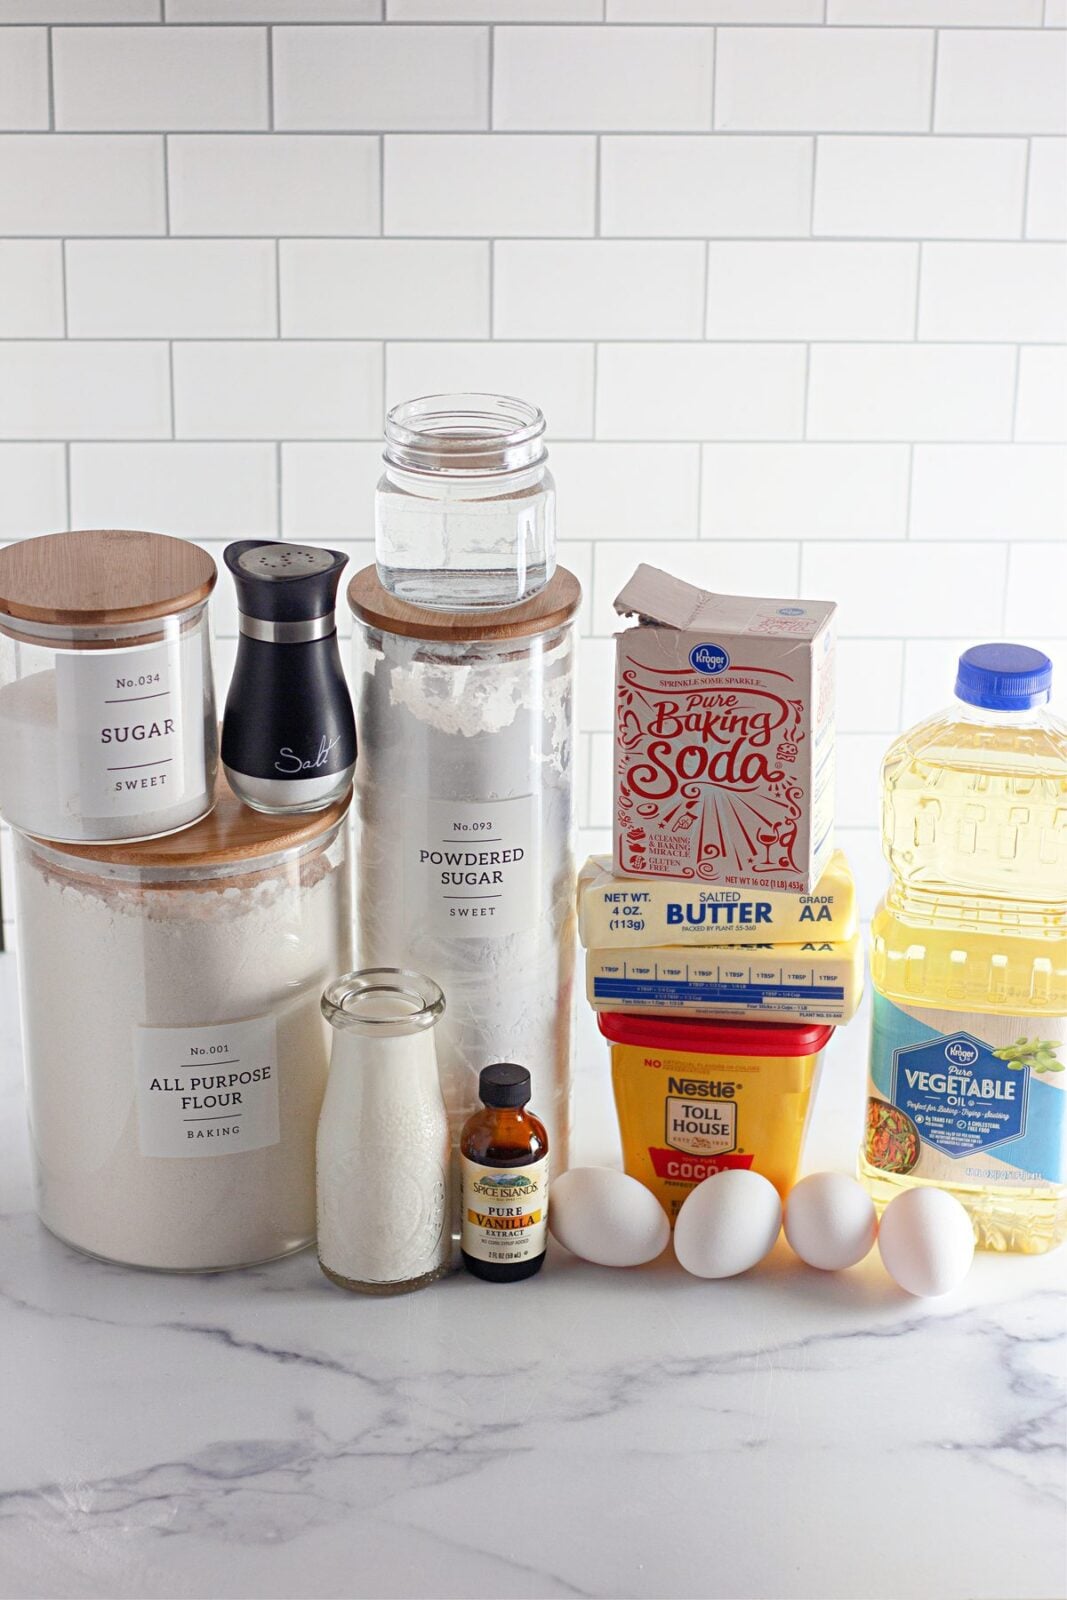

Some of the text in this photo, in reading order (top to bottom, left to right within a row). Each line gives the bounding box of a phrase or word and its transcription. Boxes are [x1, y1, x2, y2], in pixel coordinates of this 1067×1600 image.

[696, 648, 725, 670] Kroger
[116, 673, 160, 688] No.034
[659, 678, 699, 688] SPRINKLE
[700, 676, 724, 685] SOME
[686, 694, 739, 711] Pure
[101, 719, 175, 743] SUGAR
[647, 701, 772, 747] Baking
[274, 734, 341, 773] Salt
[627, 737, 785, 799] Soda
[115, 774, 167, 791] SWEET
[453, 822, 492, 831] No.093
[654, 834, 691, 844] CLEANING
[657, 841, 691, 851] BAKING
[419, 848, 524, 866] POWDERED
[649, 847, 691, 858] MIRACLE
[649, 857, 681, 866] GLUTEN
[649, 864, 671, 872] FREE
[441, 870, 503, 885] SUGAR
[725, 876, 738, 884] NET
[740, 876, 751, 885] WT
[751, 878, 759, 886] 16
[760, 879, 769, 887] OZ
[788, 881, 804, 892] 453g
[604, 892, 651, 903] NET WT.
[699, 892, 741, 903] SALTED
[799, 896, 834, 904] GRADE
[450, 907, 496, 917] SWEET
[612, 906, 642, 916] 4 OZ.
[666, 902, 773, 925] BUTTER
[798, 905, 832, 922] AA
[609, 919, 645, 931] (113g)
[190, 1044, 229, 1056] No.001
[950, 1044, 975, 1062] Kroger
[644, 1059, 661, 1068] NO
[948, 1065, 973, 1077] Pure
[150, 1066, 271, 1091] ALL PURPOSE
[904, 1068, 1016, 1100] VEGETABLE
[182, 1092, 243, 1110] FLOUR
[947, 1096, 966, 1107] OIL
[681, 1104, 722, 1120] TOLL
[187, 1125, 240, 1139] BAKING
[673, 1119, 730, 1135] HOUSE
[667, 1161, 729, 1179] COCO
[473, 1181, 539, 1198] SPICE ISLANDS
[488, 1206, 522, 1217] PURE
[476, 1214, 535, 1230] VANILLA
[486, 1229, 525, 1238] EXTRACT
